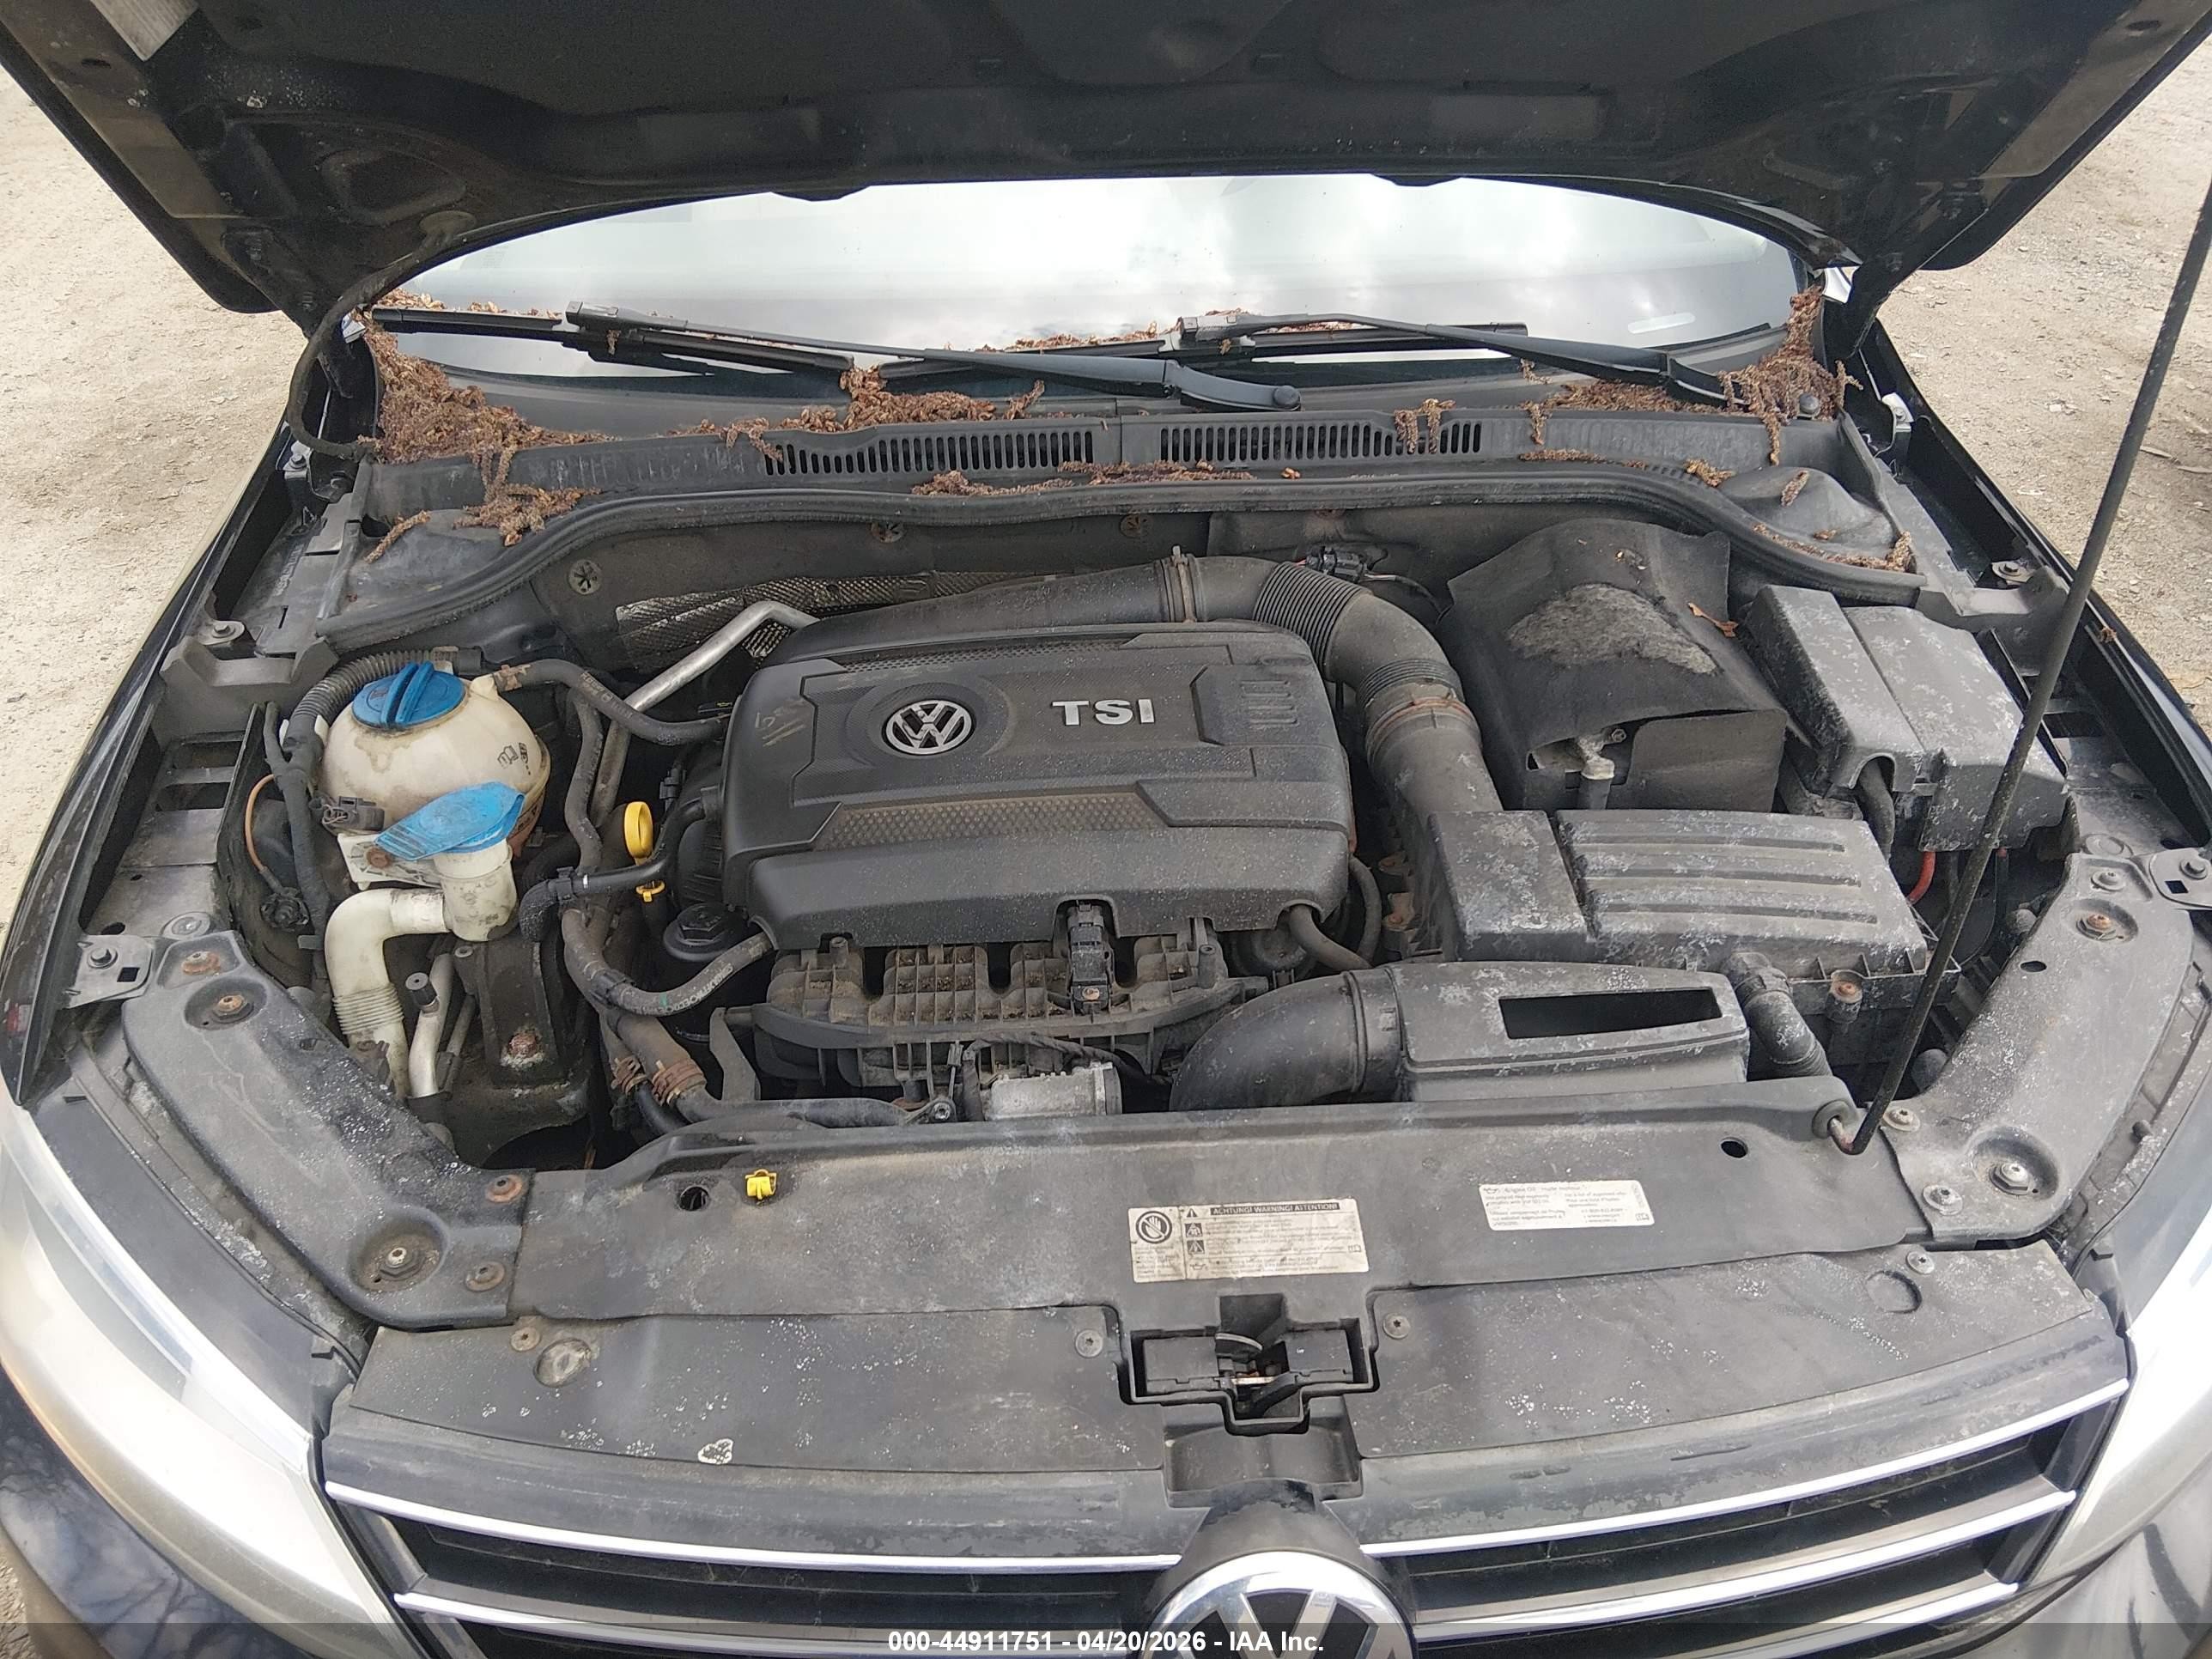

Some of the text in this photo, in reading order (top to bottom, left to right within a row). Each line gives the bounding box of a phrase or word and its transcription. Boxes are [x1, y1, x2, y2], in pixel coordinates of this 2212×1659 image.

[1052, 699, 1155, 726] TSI
[1212, 1202, 1339, 1215] ACHTUNG! WARNING! ATTENTION!
